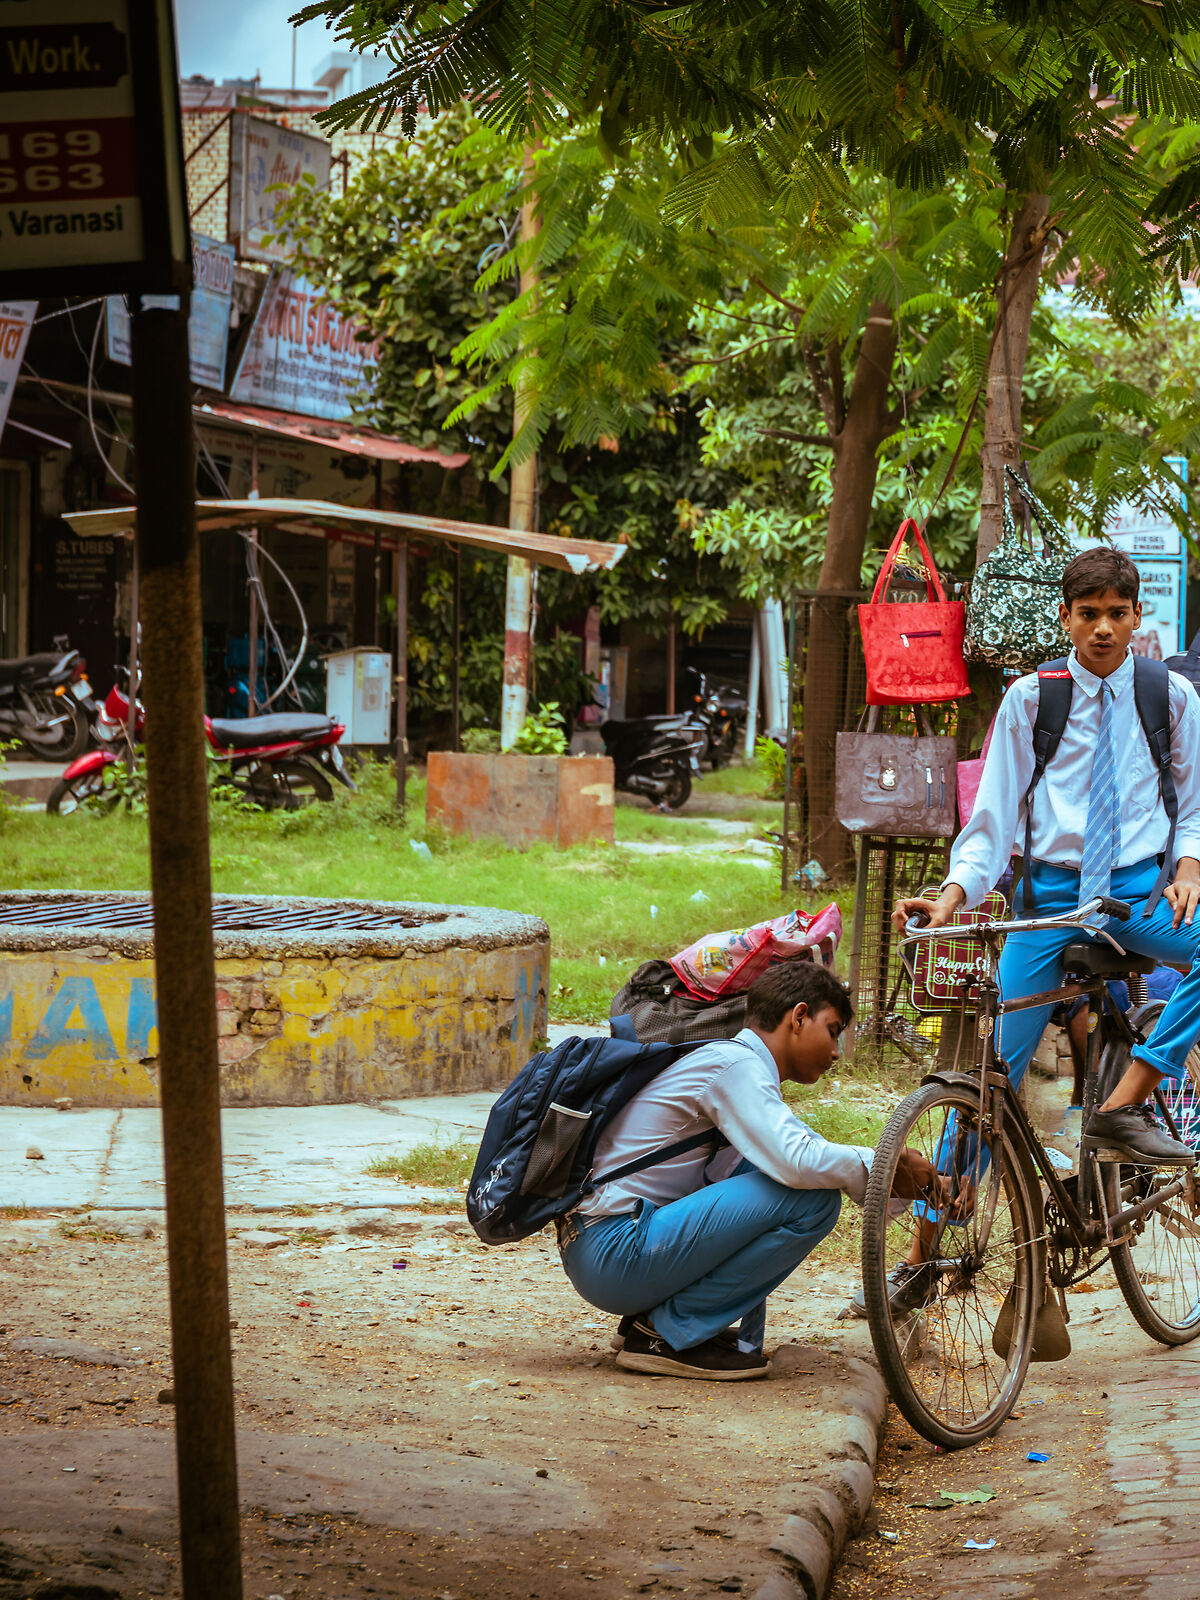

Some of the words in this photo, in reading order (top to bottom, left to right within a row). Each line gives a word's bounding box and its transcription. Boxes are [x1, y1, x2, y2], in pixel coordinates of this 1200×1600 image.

[8, 35, 101, 75] Work.
[8, 205, 124, 237] Varanasi
[1141, 572, 1172, 583] GRASS
[1143, 586, 1173, 597] MOWER
[935, 956, 975, 973] Happy
